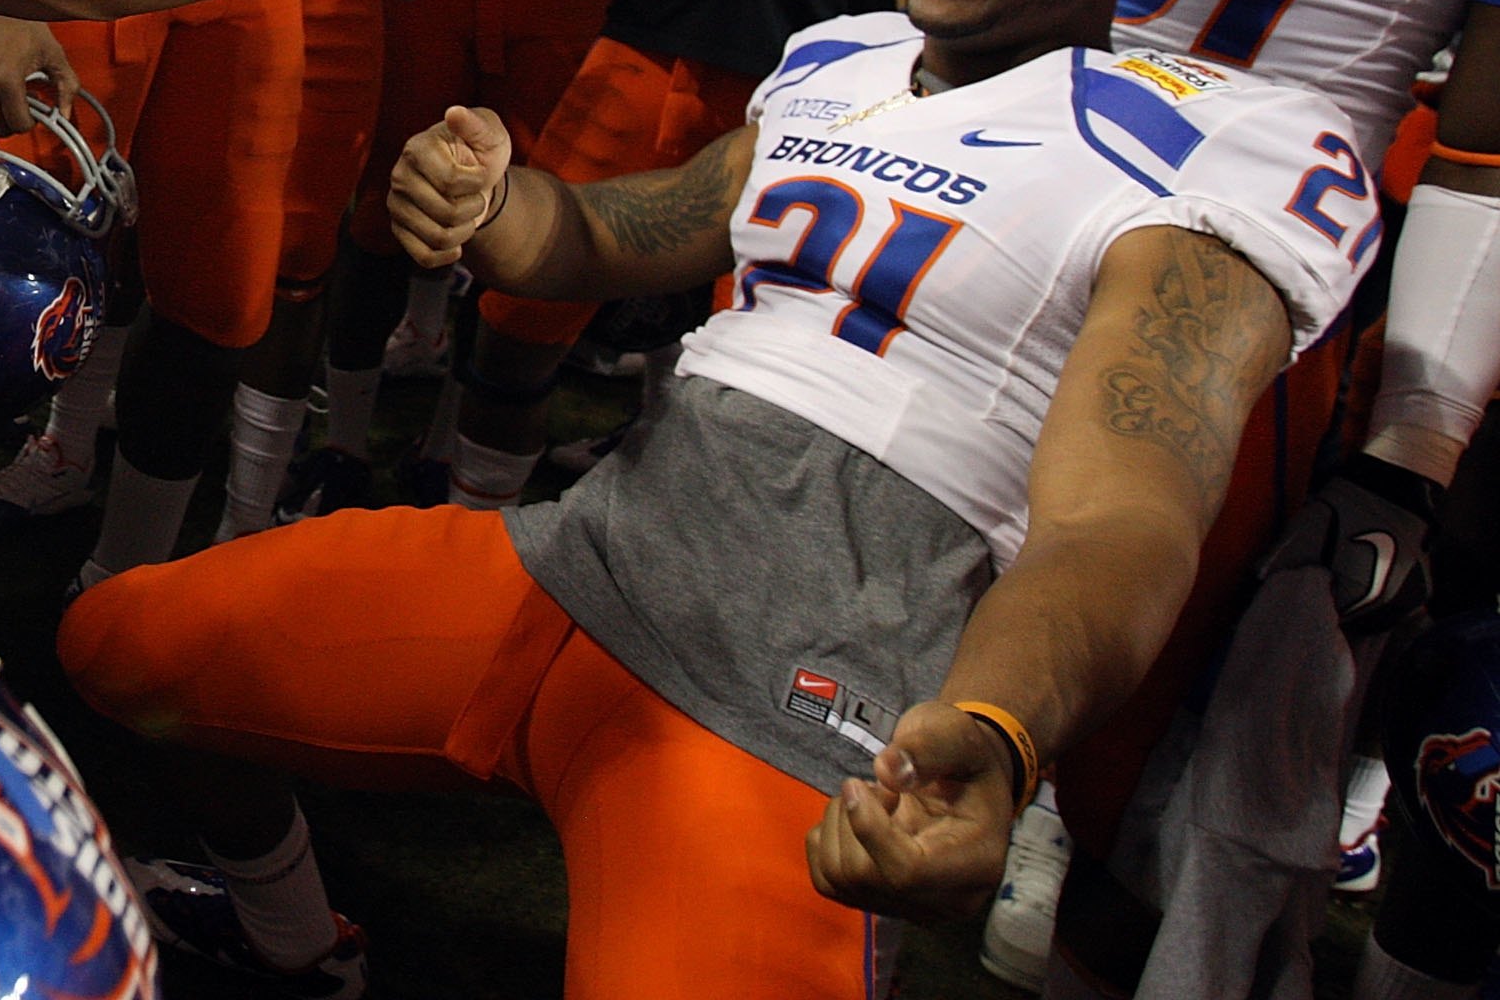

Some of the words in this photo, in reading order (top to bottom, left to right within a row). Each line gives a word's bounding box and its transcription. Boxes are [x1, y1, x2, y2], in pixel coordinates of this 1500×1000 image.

[767, 135, 988, 206] BRONCOS
[730, 175, 966, 359] 21
[854, 701, 871, 726] L
